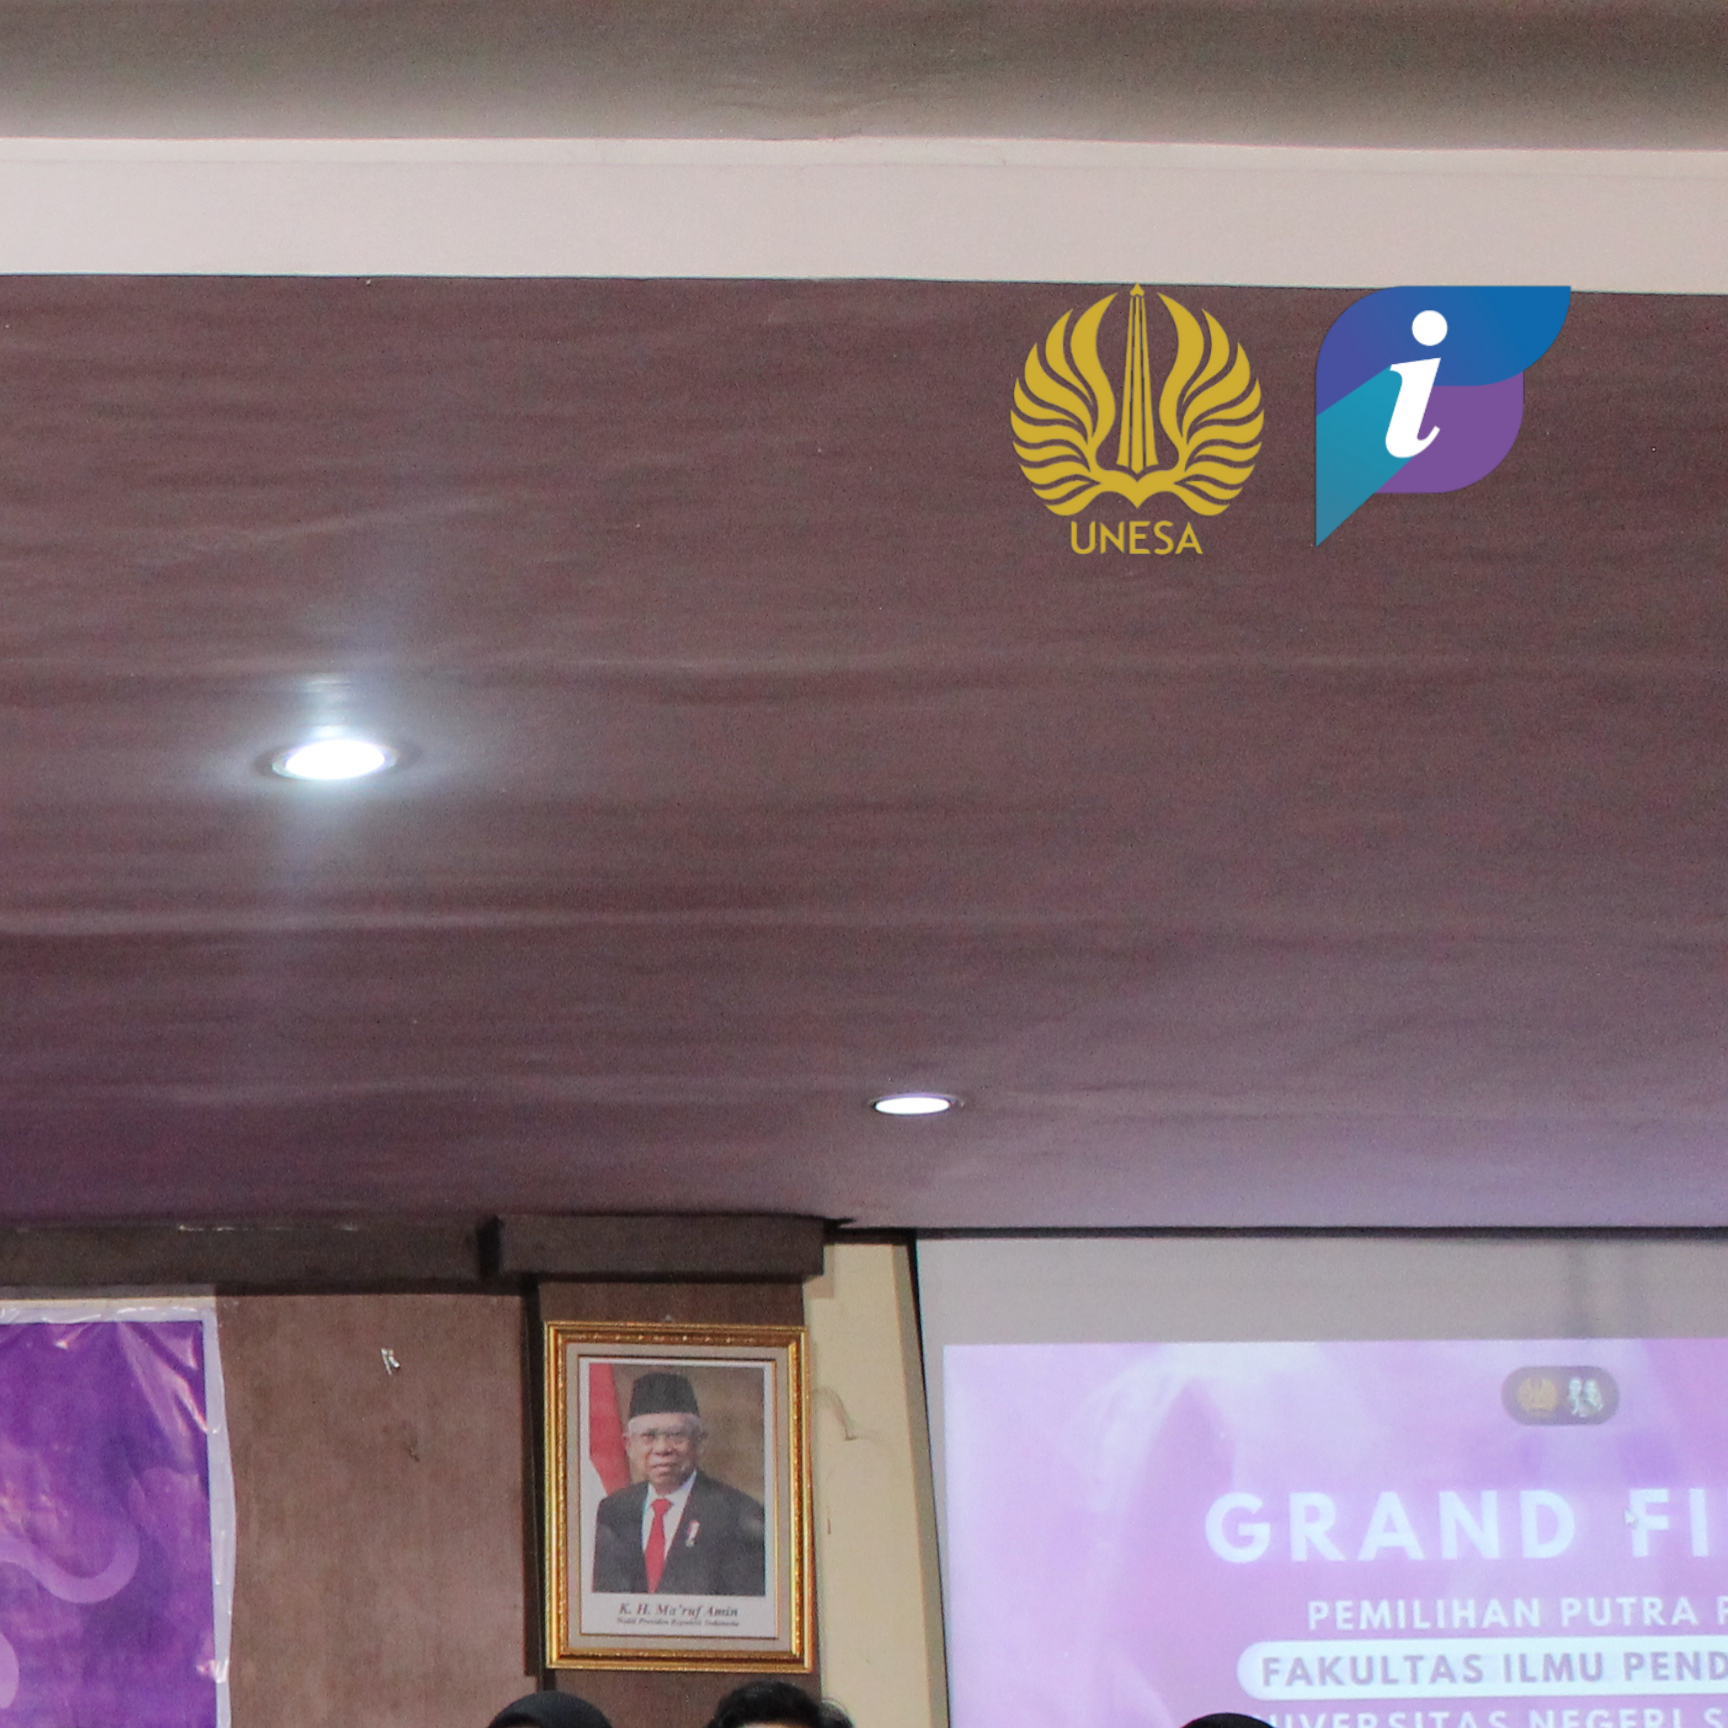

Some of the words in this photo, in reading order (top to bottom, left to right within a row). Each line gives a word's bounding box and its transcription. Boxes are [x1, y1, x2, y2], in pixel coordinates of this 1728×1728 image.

[1204, 1489, 1576, 1563] GRAND
[1307, 1598, 1541, 1631] PEMILIHAN
[1560, 1596, 1699, 1627] PUTRA
[1261, 1653, 1484, 1687] FAKULTAS
[1503, 1651, 1604, 1684] ILMU
